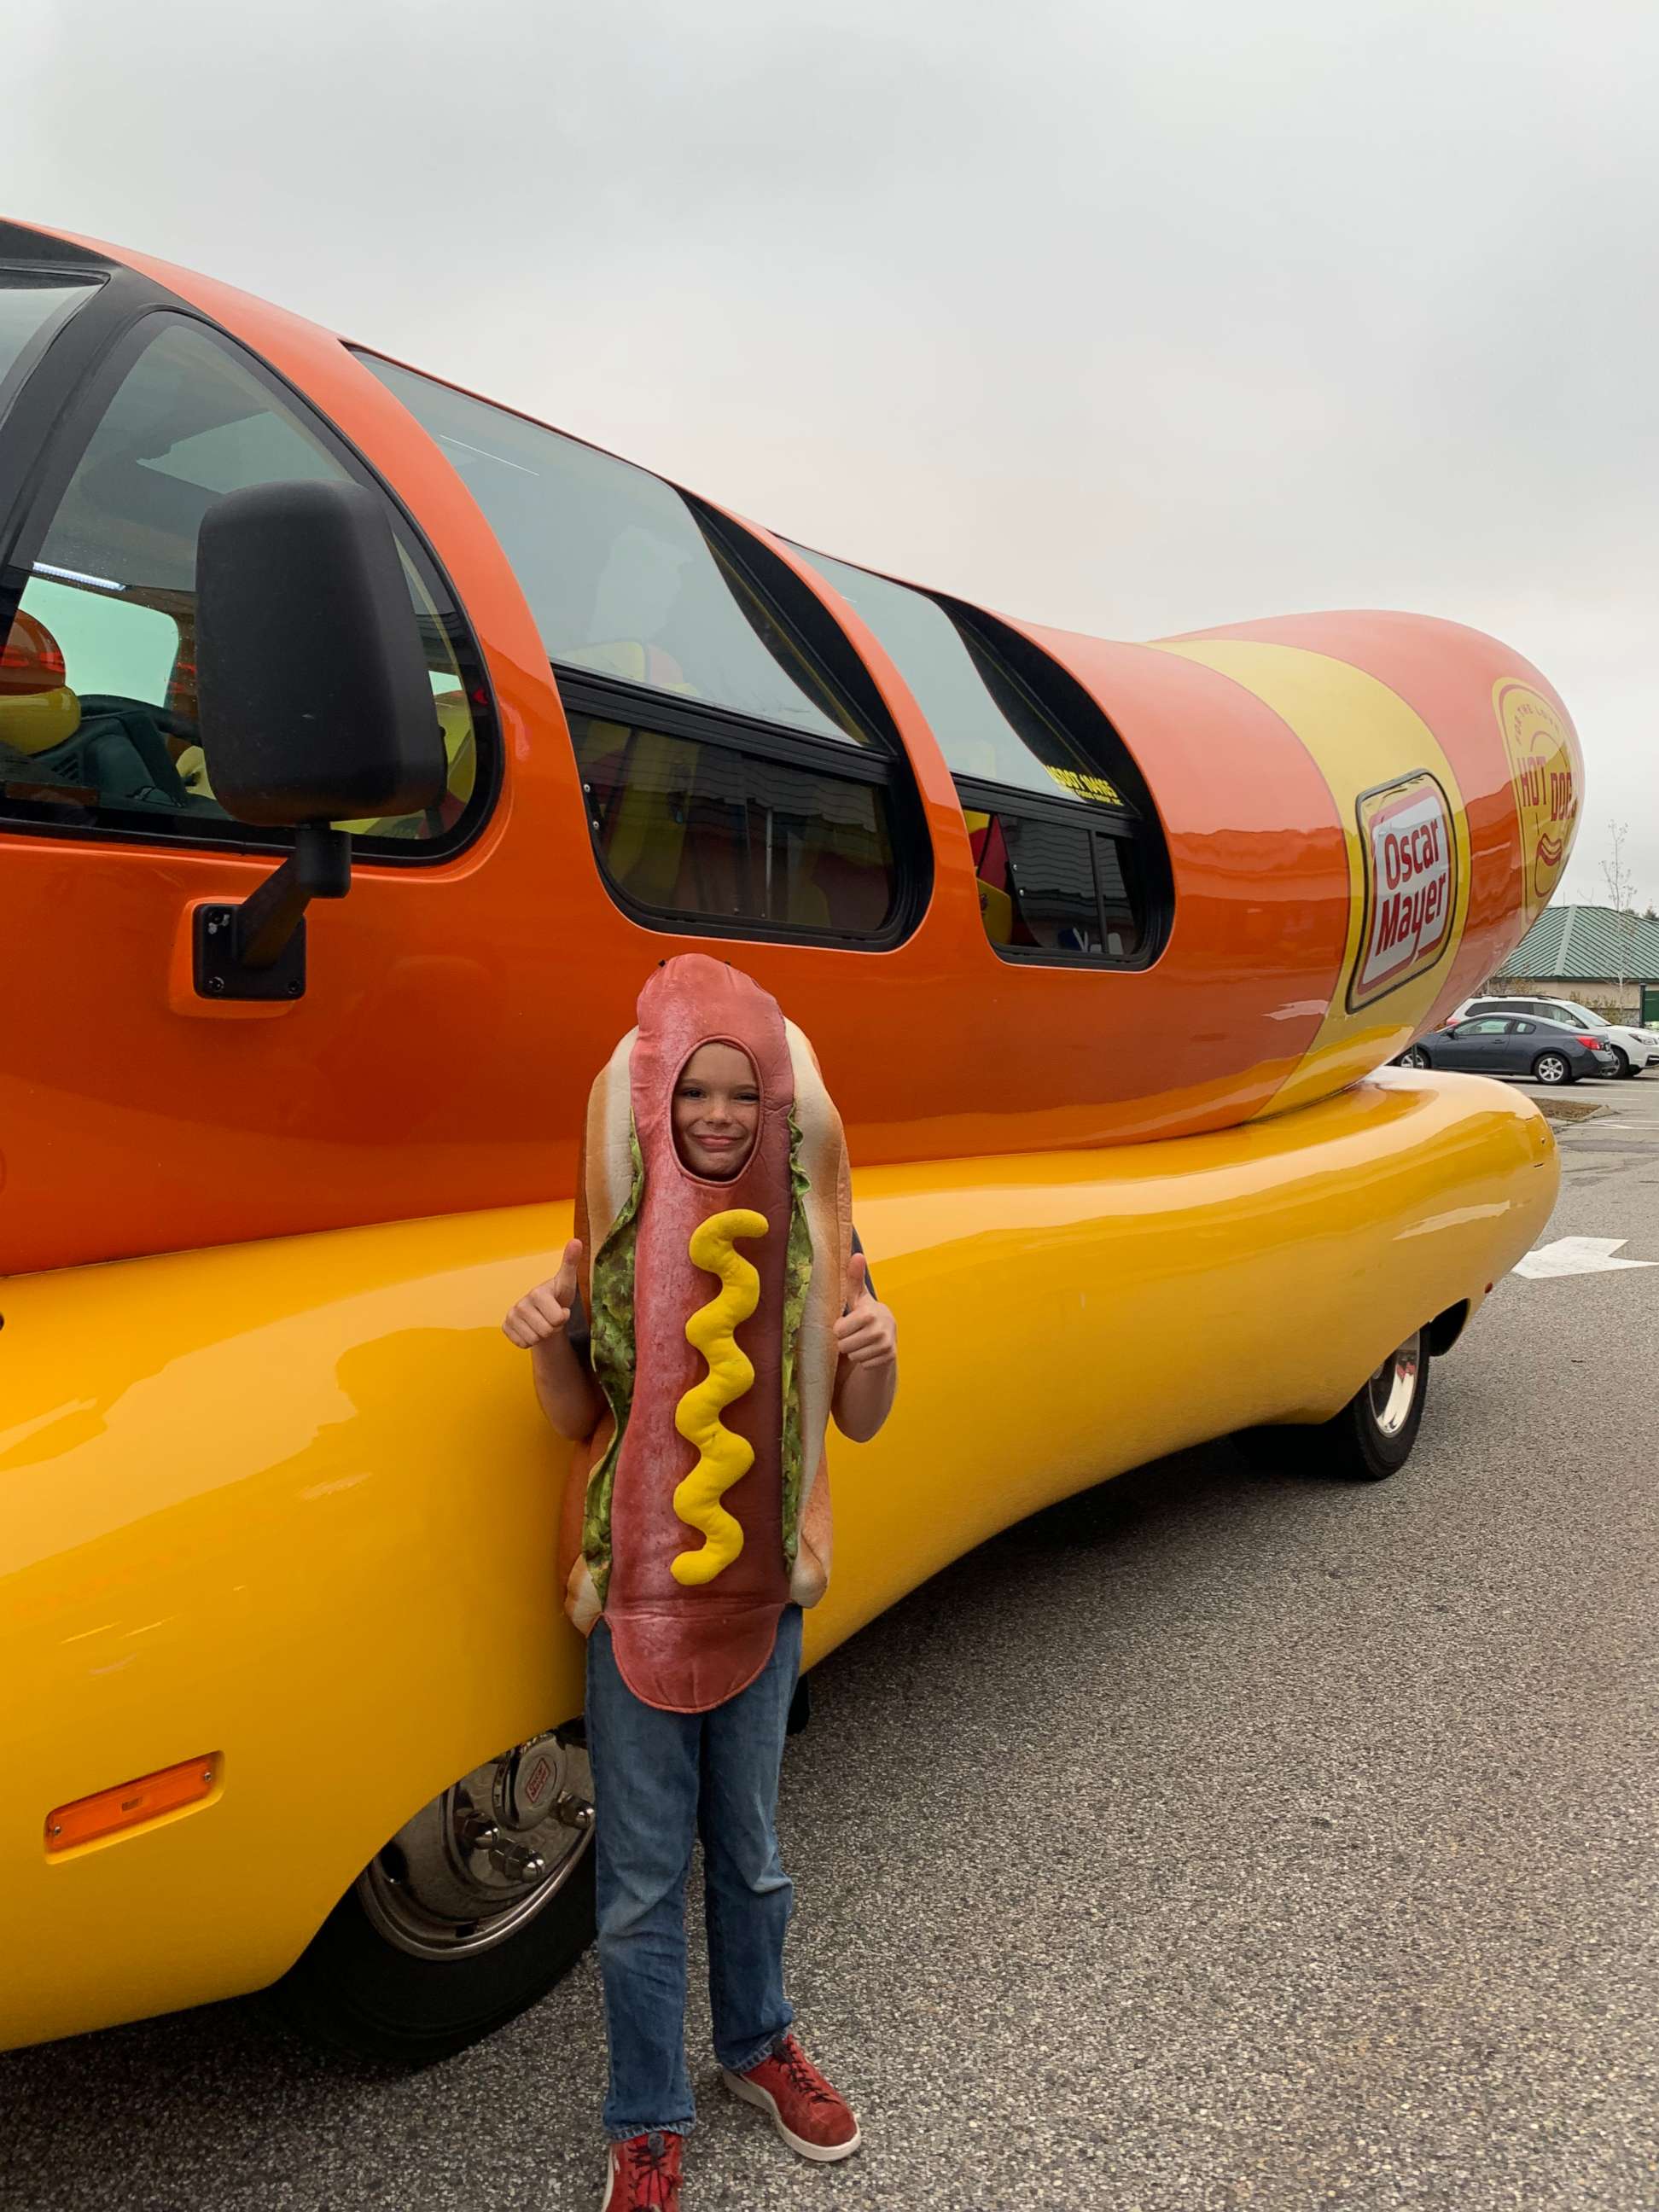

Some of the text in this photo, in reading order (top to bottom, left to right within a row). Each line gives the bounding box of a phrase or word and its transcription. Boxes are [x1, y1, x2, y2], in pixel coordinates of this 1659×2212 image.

[1516, 756, 1546, 807] HOT
[1383, 818, 1439, 891] Oscar
[1374, 871, 1447, 958] Mayer
